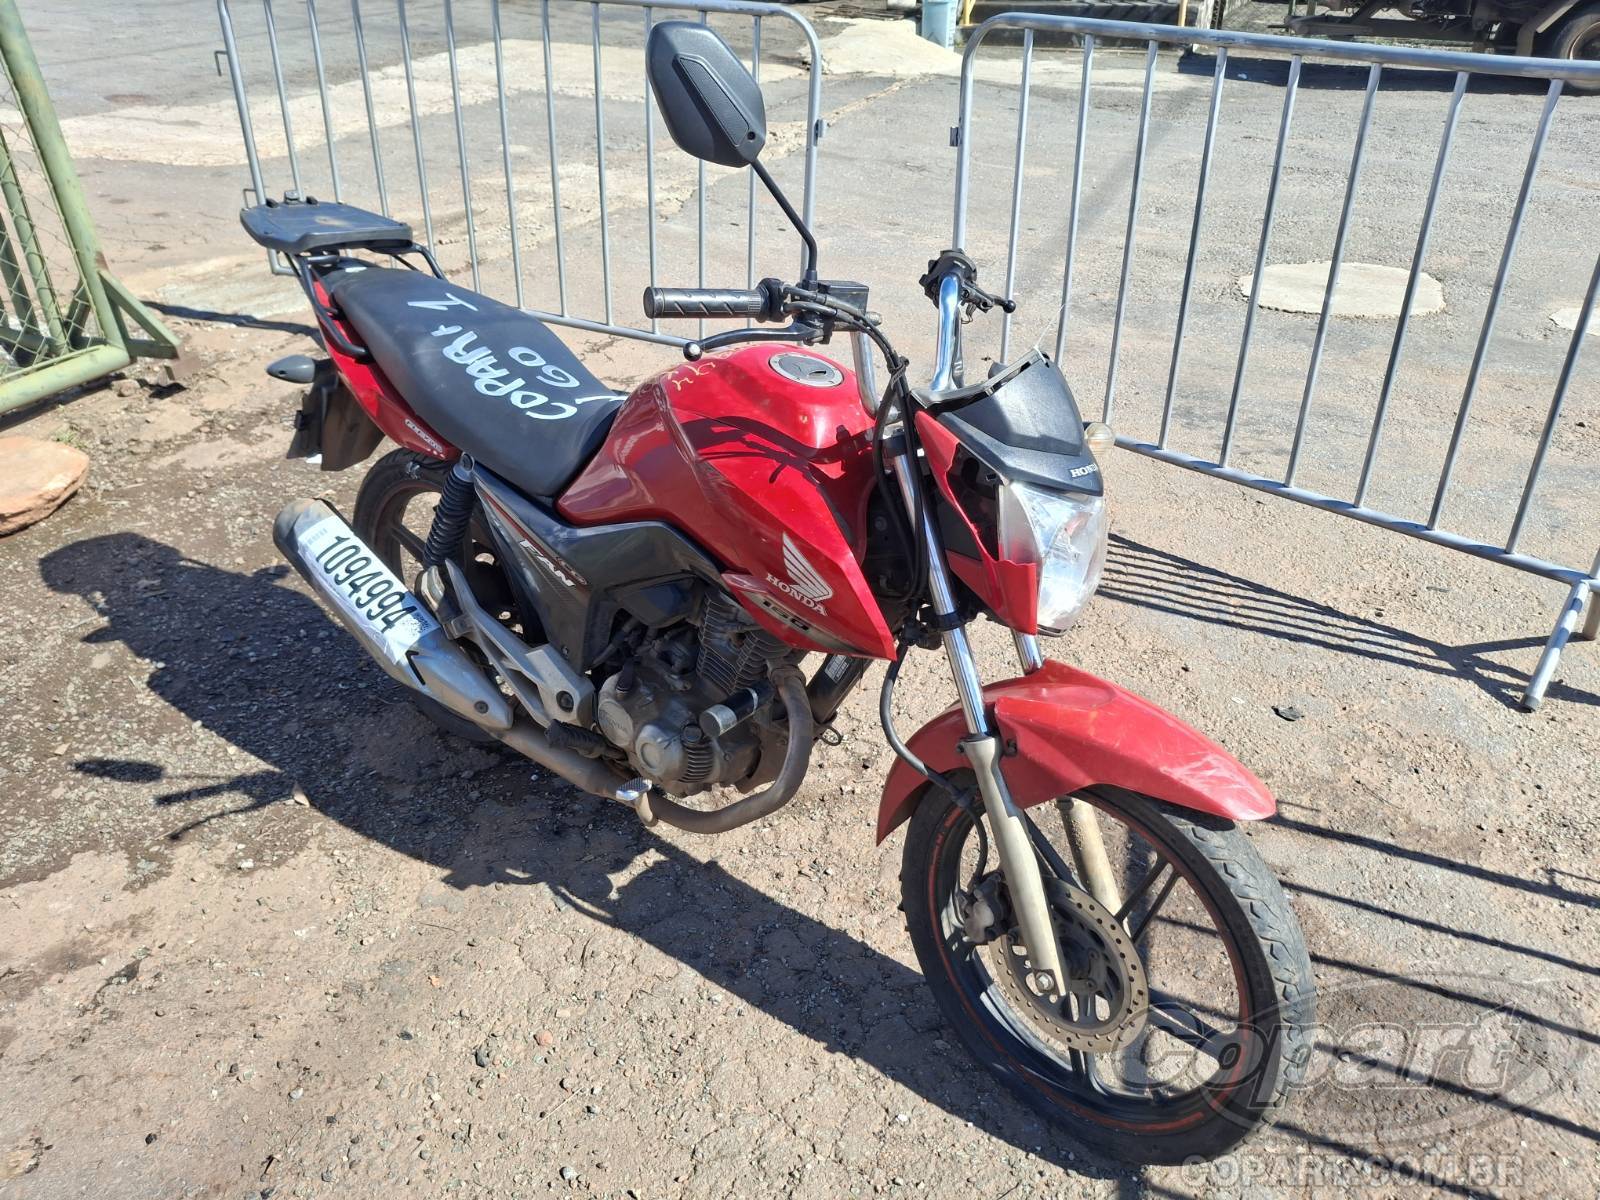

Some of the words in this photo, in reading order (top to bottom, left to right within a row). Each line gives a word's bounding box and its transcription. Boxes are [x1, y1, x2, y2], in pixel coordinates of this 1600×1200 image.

[316, 535, 418, 634] 1094994
[519, 539, 577, 587] FAN
[765, 573, 828, 617] HONDA
